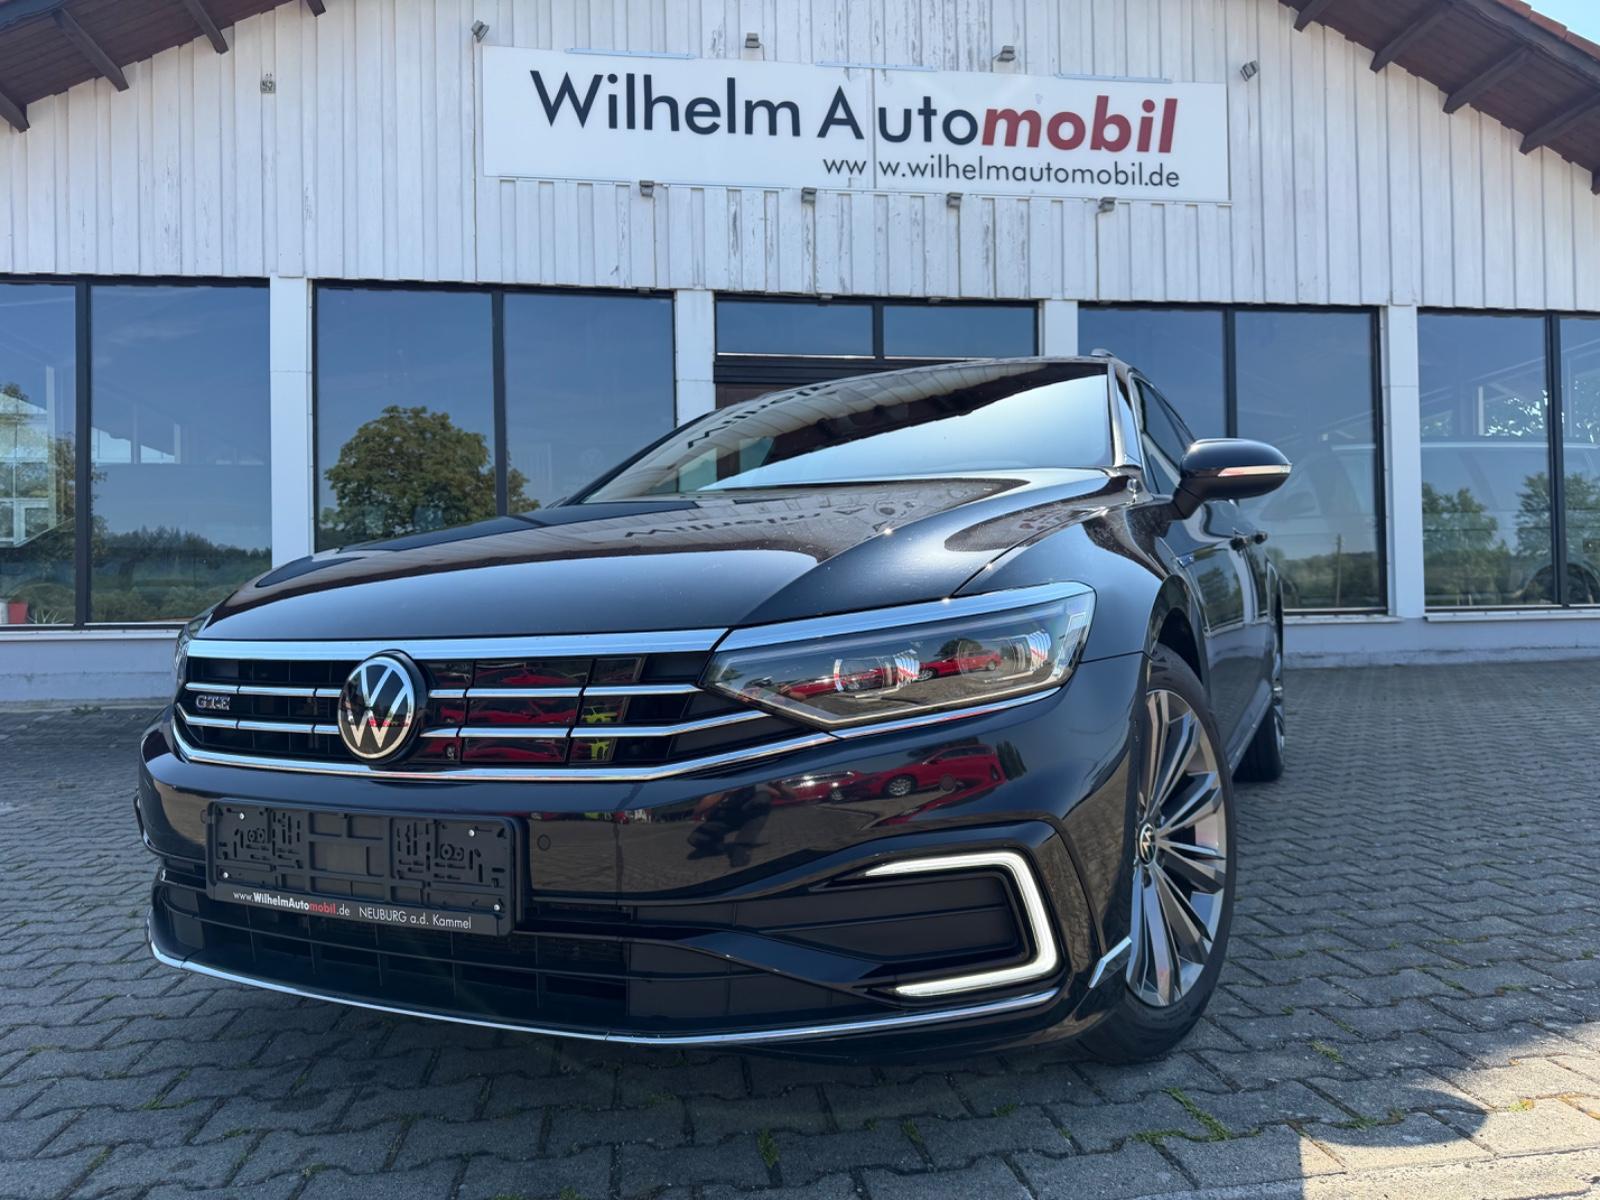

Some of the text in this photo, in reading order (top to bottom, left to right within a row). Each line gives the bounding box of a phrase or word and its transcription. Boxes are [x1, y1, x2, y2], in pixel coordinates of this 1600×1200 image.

[530, 70, 801, 137] Wilhelm
[359, 906, 407, 923] NEUBURG
[409, 911, 429, 925] a.d.
[432, 913, 472, 930] Kammel
